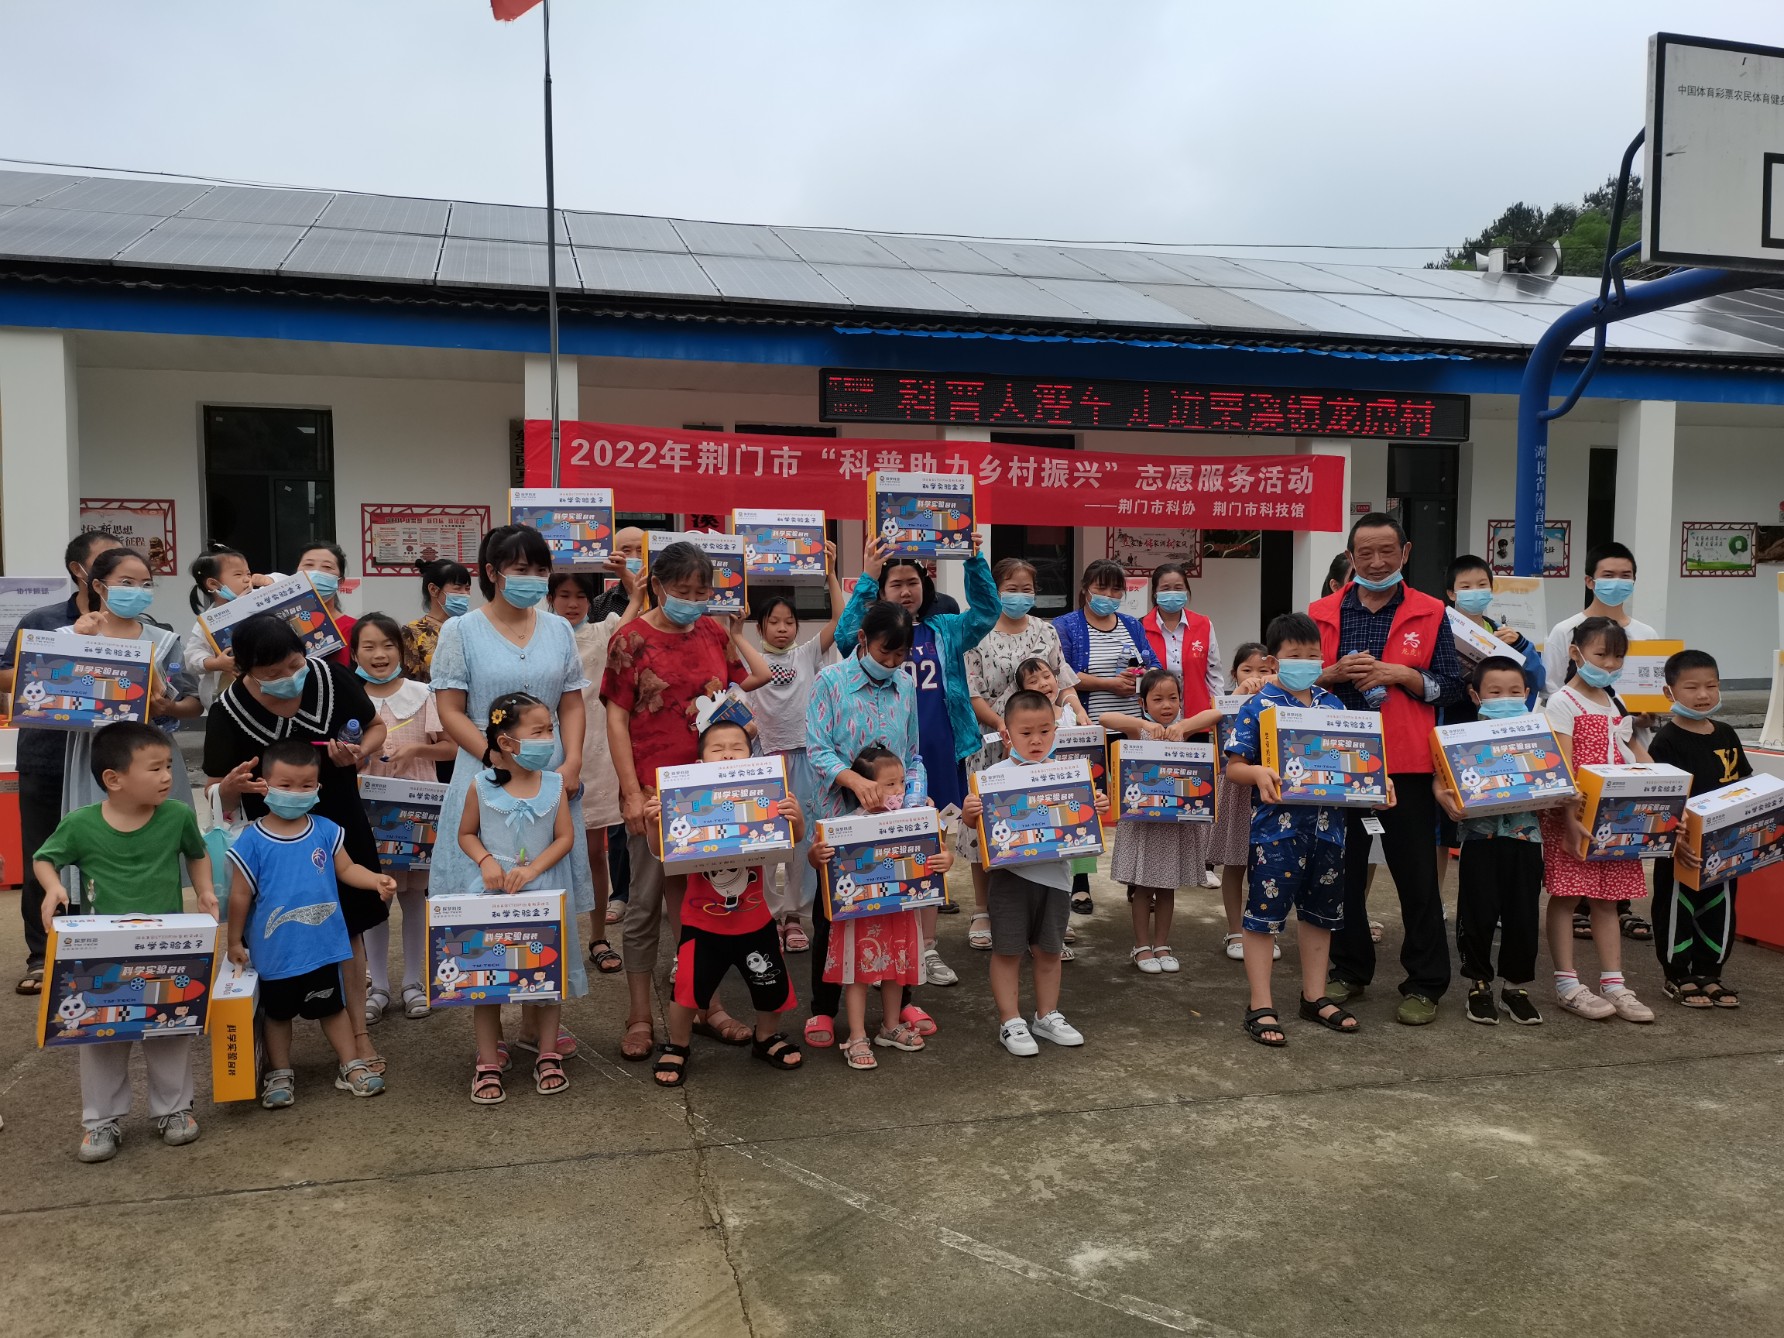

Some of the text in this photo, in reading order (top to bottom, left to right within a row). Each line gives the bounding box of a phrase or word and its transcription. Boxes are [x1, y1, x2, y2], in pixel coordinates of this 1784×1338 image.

[1212, 501, 1305, 518] 荆门市科技馆
[84, 646, 141, 658] 科学实验盒子
[491, 907, 550, 918] 科学实验盒子
[134, 940, 204, 950] 科学实验盒子
